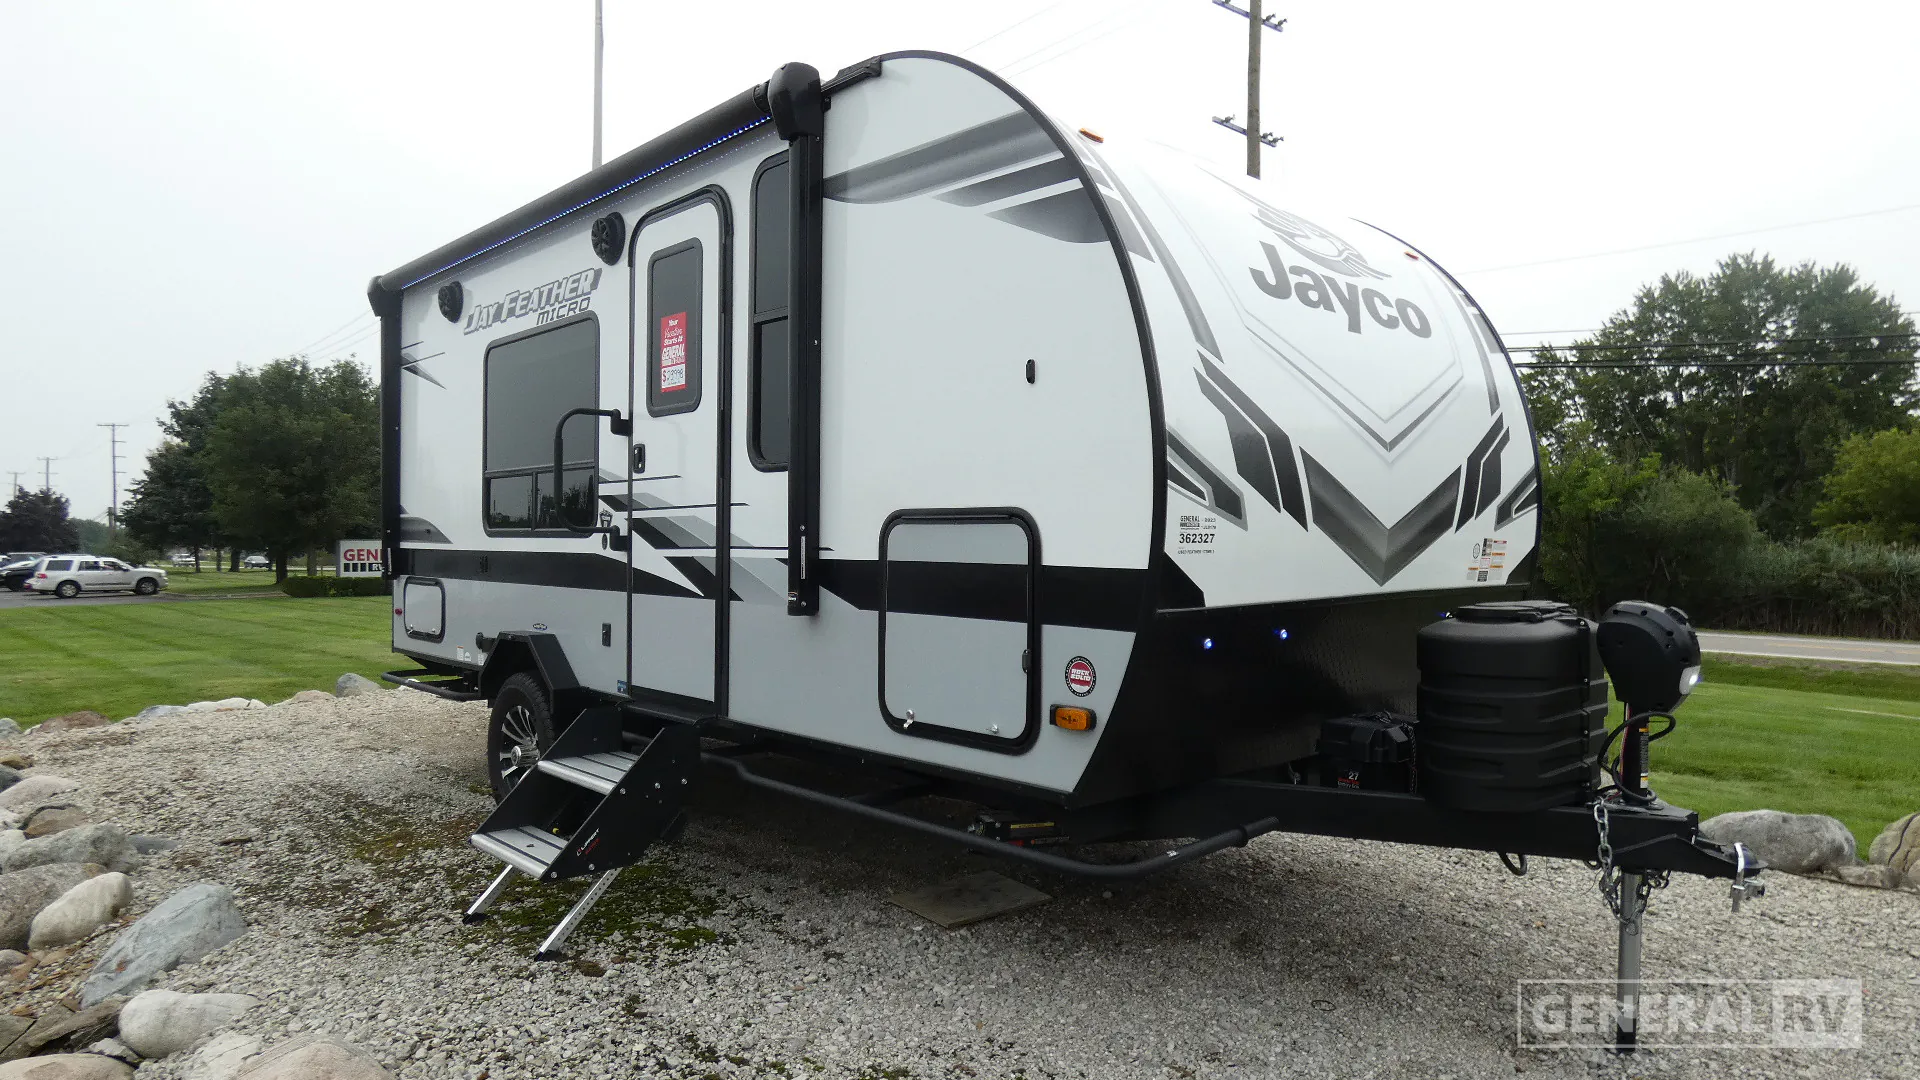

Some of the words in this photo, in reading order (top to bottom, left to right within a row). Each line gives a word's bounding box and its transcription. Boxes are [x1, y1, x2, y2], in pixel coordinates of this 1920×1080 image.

[1249, 240, 1432, 339] Jayco
[464, 301, 499, 335] JAY
[500, 267, 595, 323] FEATHER
[537, 297, 591, 326] MICRO
[1178, 533, 1216, 544] 362327
[1071, 668, 1090, 676] ROCK
[1070, 674, 1092, 682] SOLID
[1348, 771, 1359, 780] 27
